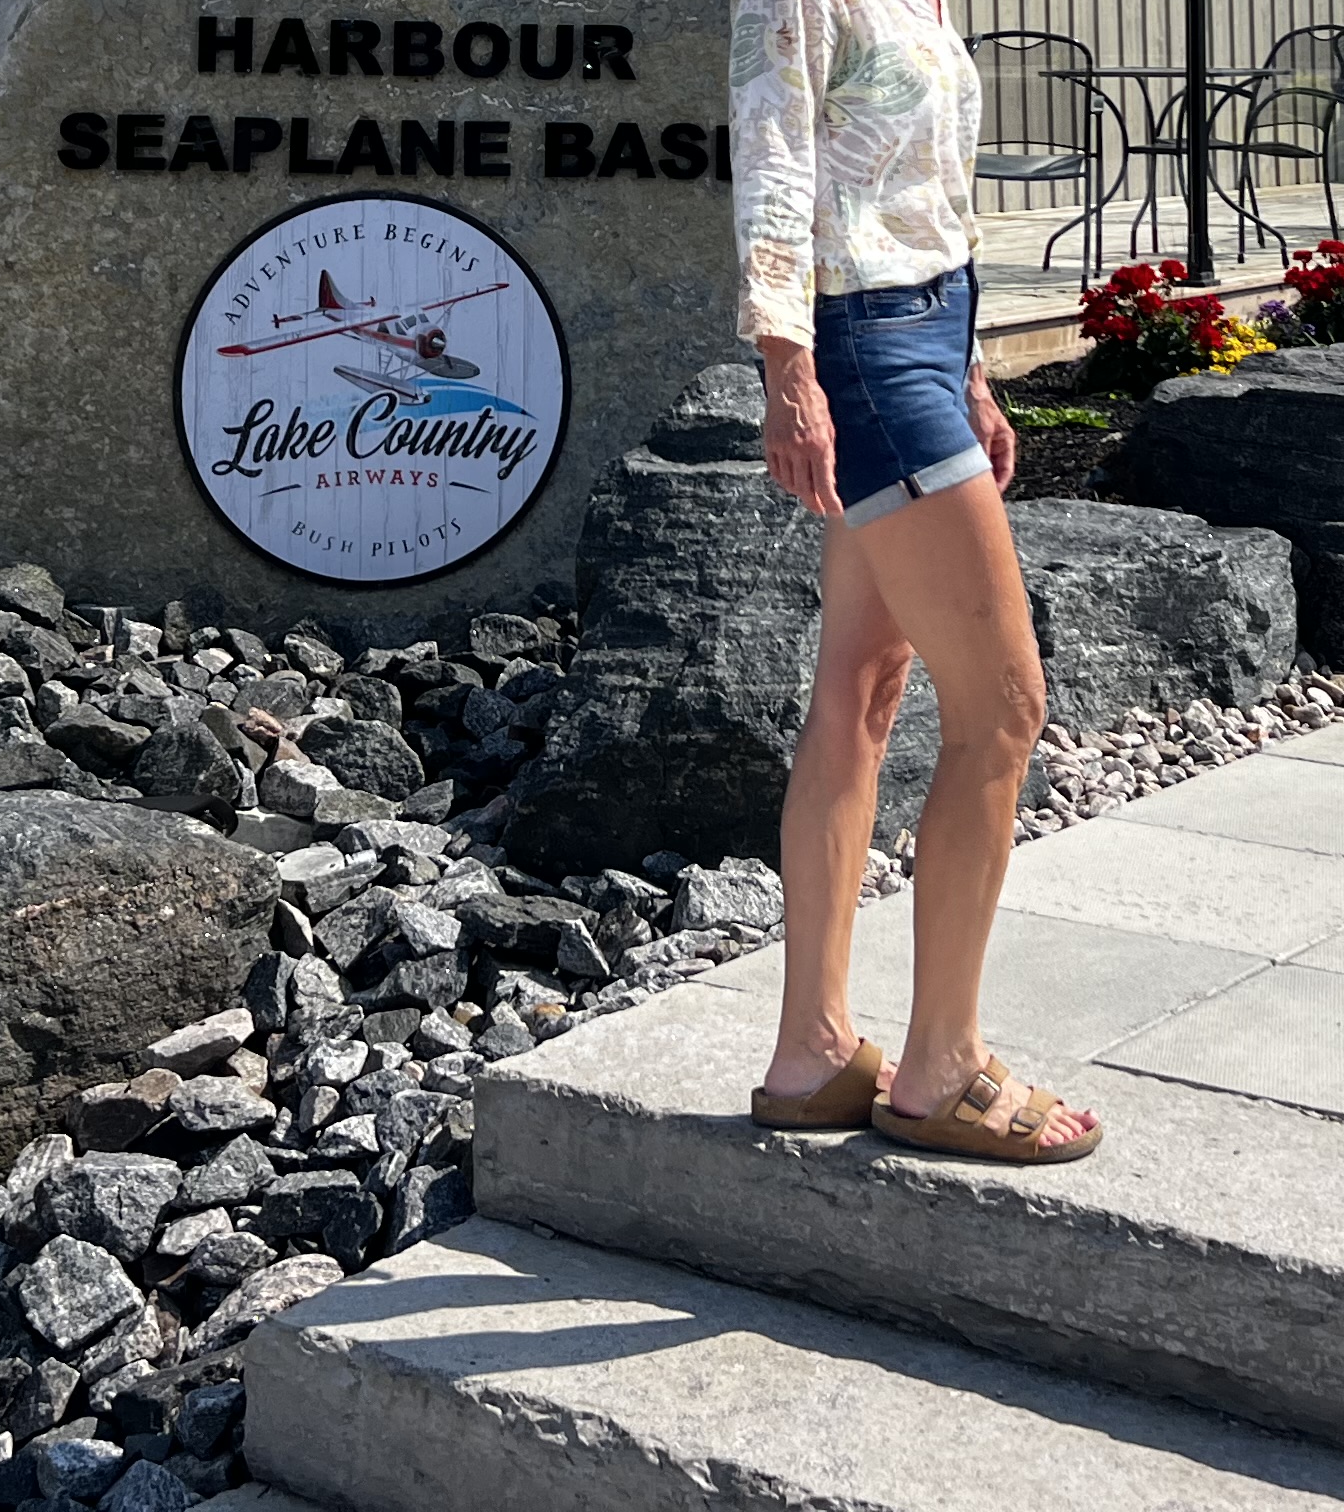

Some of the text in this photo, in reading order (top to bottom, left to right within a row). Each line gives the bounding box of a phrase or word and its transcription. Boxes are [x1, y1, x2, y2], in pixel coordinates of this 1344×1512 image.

[197, 16, 637, 81] HARBOUR
[58, 112, 511, 177] SEAPLANE
[225, 223, 481, 325] ADVENTURE BEGINS
[212, 392, 539, 481] Lake Country
[316, 469, 439, 489] AIRWAYS
[291, 517, 462, 556] BUSH PILOTS
